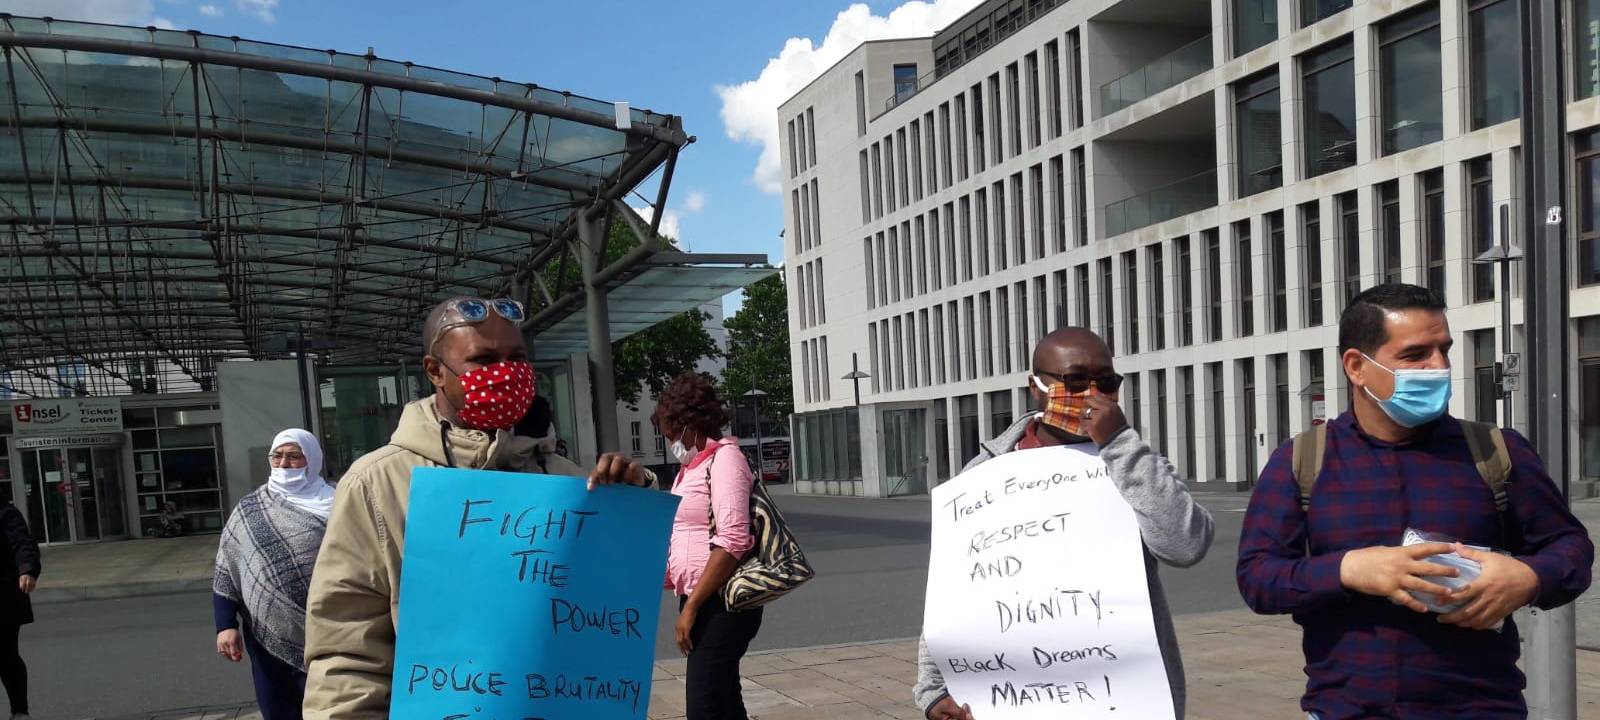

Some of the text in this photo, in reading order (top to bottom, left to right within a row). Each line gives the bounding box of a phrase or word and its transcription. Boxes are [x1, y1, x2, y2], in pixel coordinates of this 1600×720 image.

[80, 416, 117, 424] Center
[20, 435, 111, 447] Touristeninformat
[459, 499, 600, 545] FIGHT
[944, 490, 995, 522] Treat
[967, 511, 1072, 556] RESPECT
[511, 549, 574, 587] THE
[970, 555, 1022, 582] AND
[550, 598, 642, 640] POWER
[1032, 644, 1118, 669] Dreams
